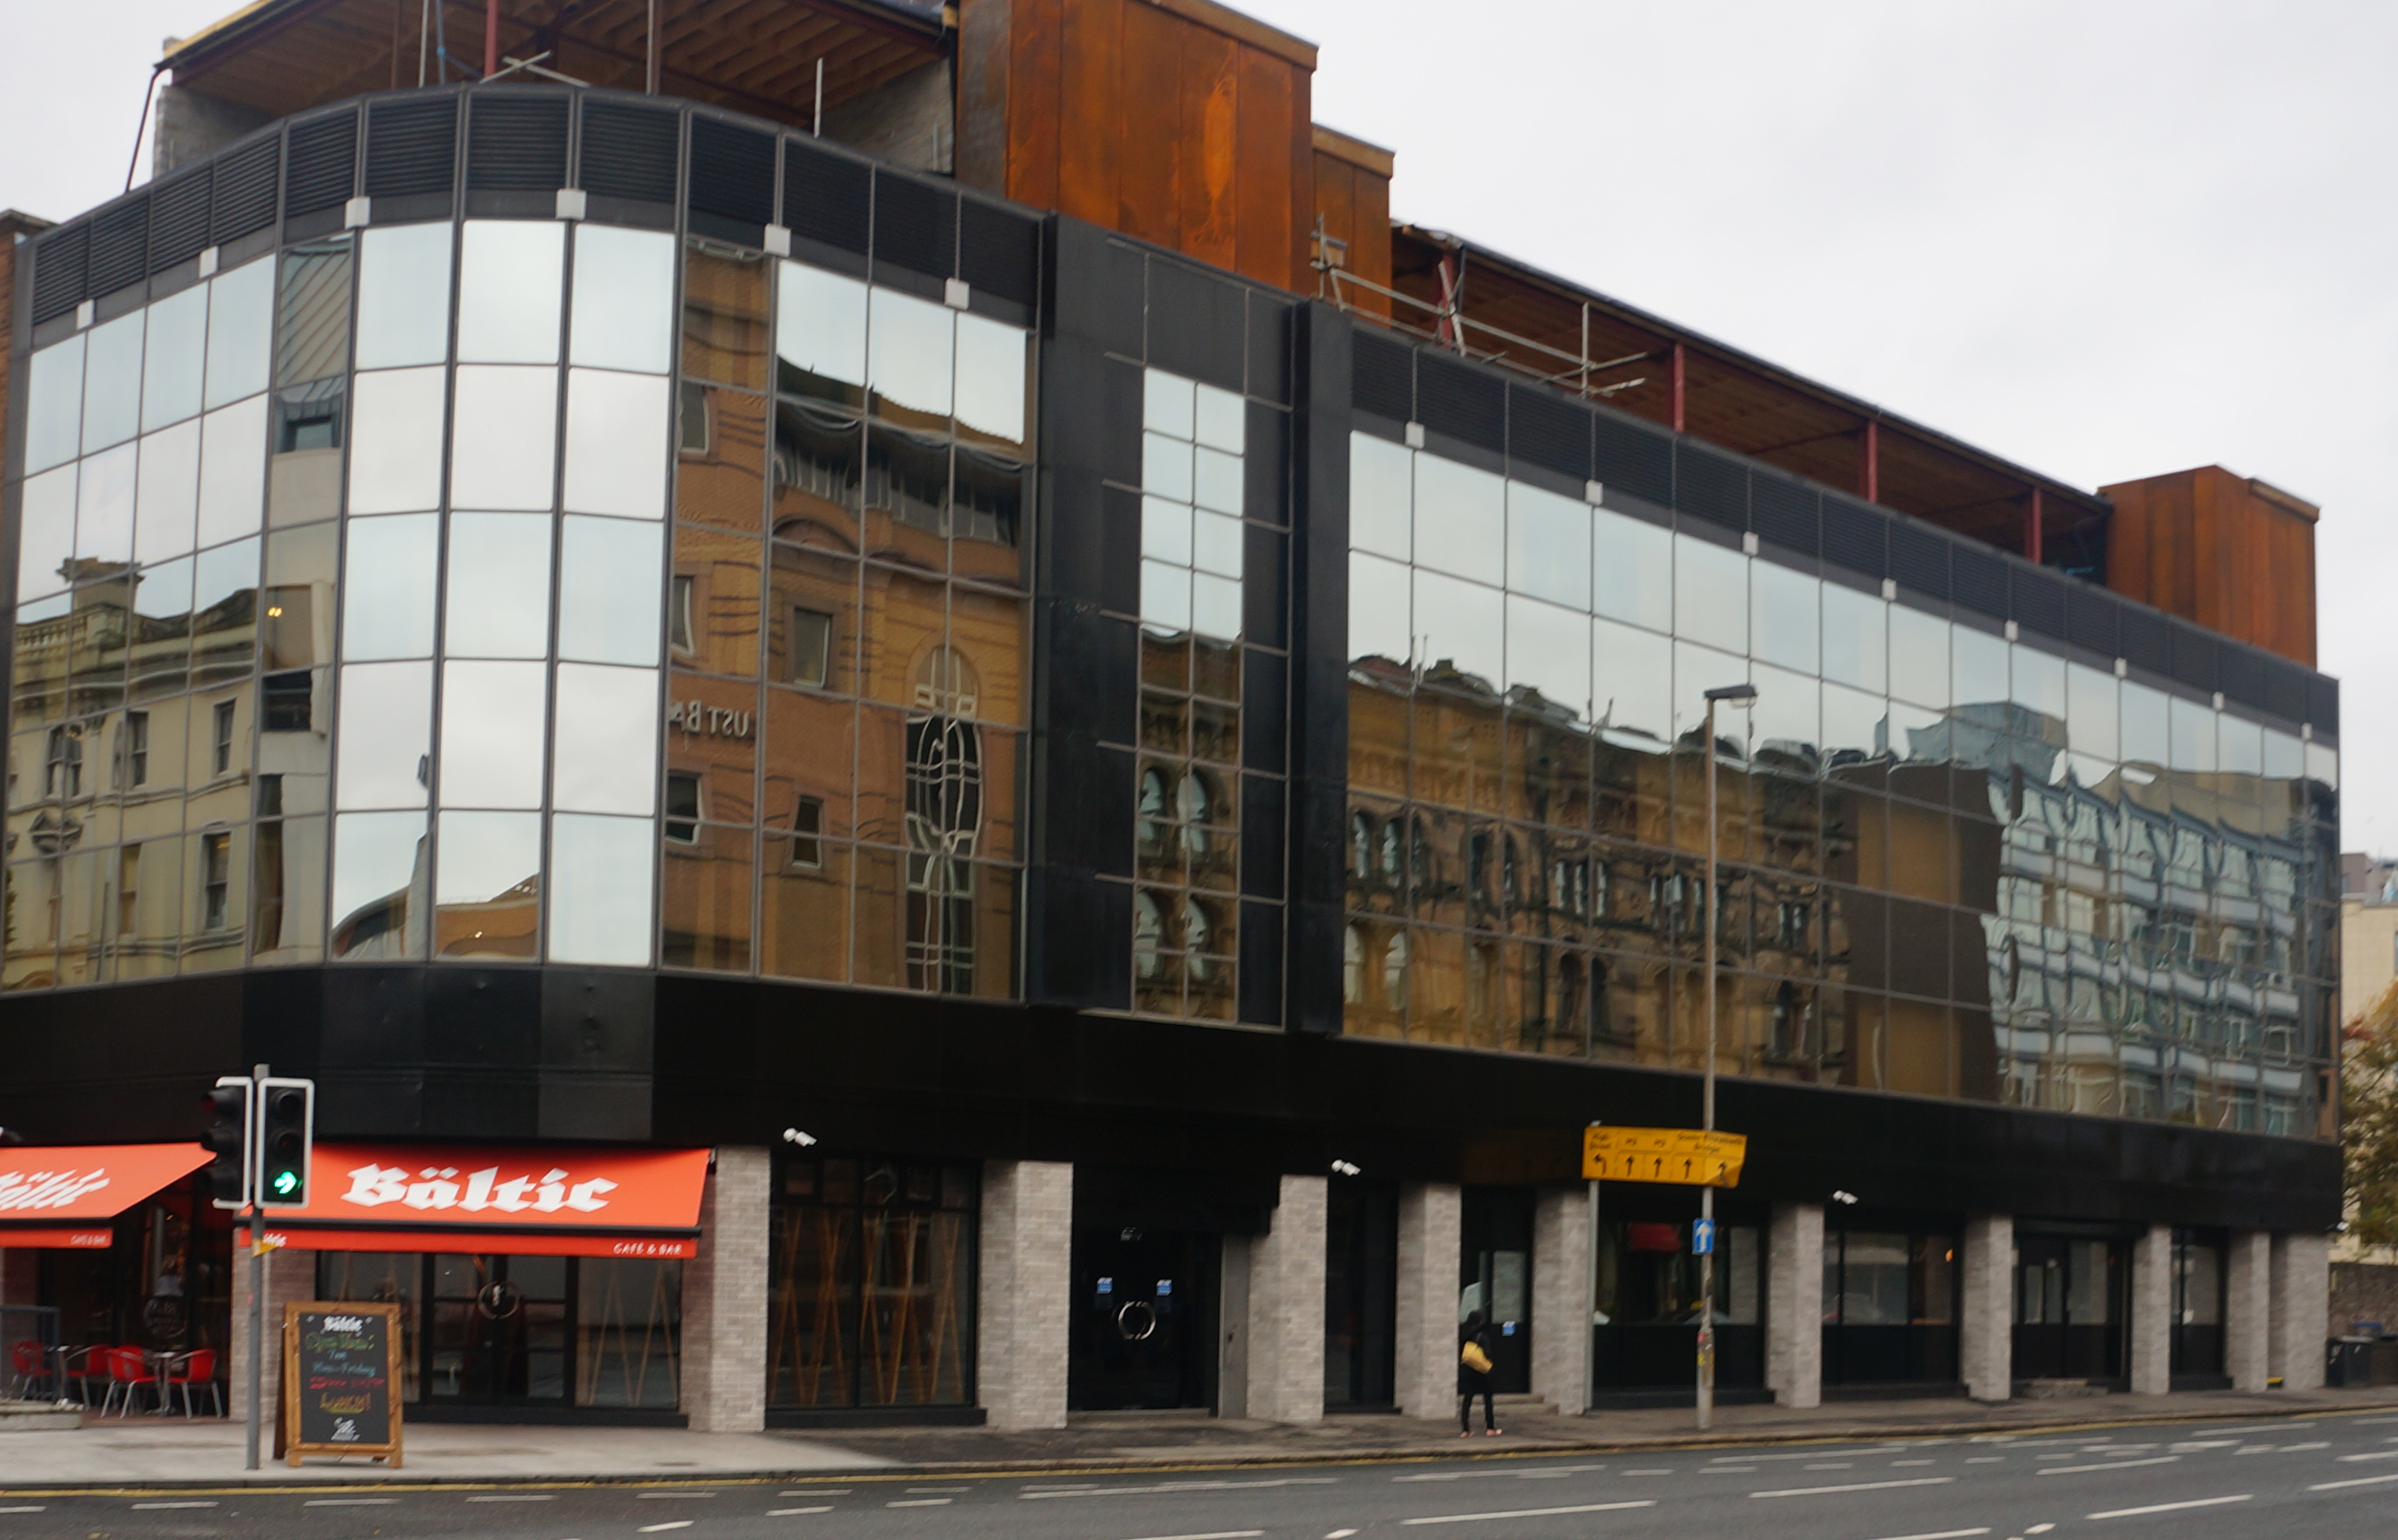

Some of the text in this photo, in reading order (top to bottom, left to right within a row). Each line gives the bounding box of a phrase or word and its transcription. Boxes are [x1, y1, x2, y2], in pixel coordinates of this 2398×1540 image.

[340, 1163, 619, 1212] Bältic
[646, 1243, 656, 1255] &
[658, 1243, 683, 1255] BAR
